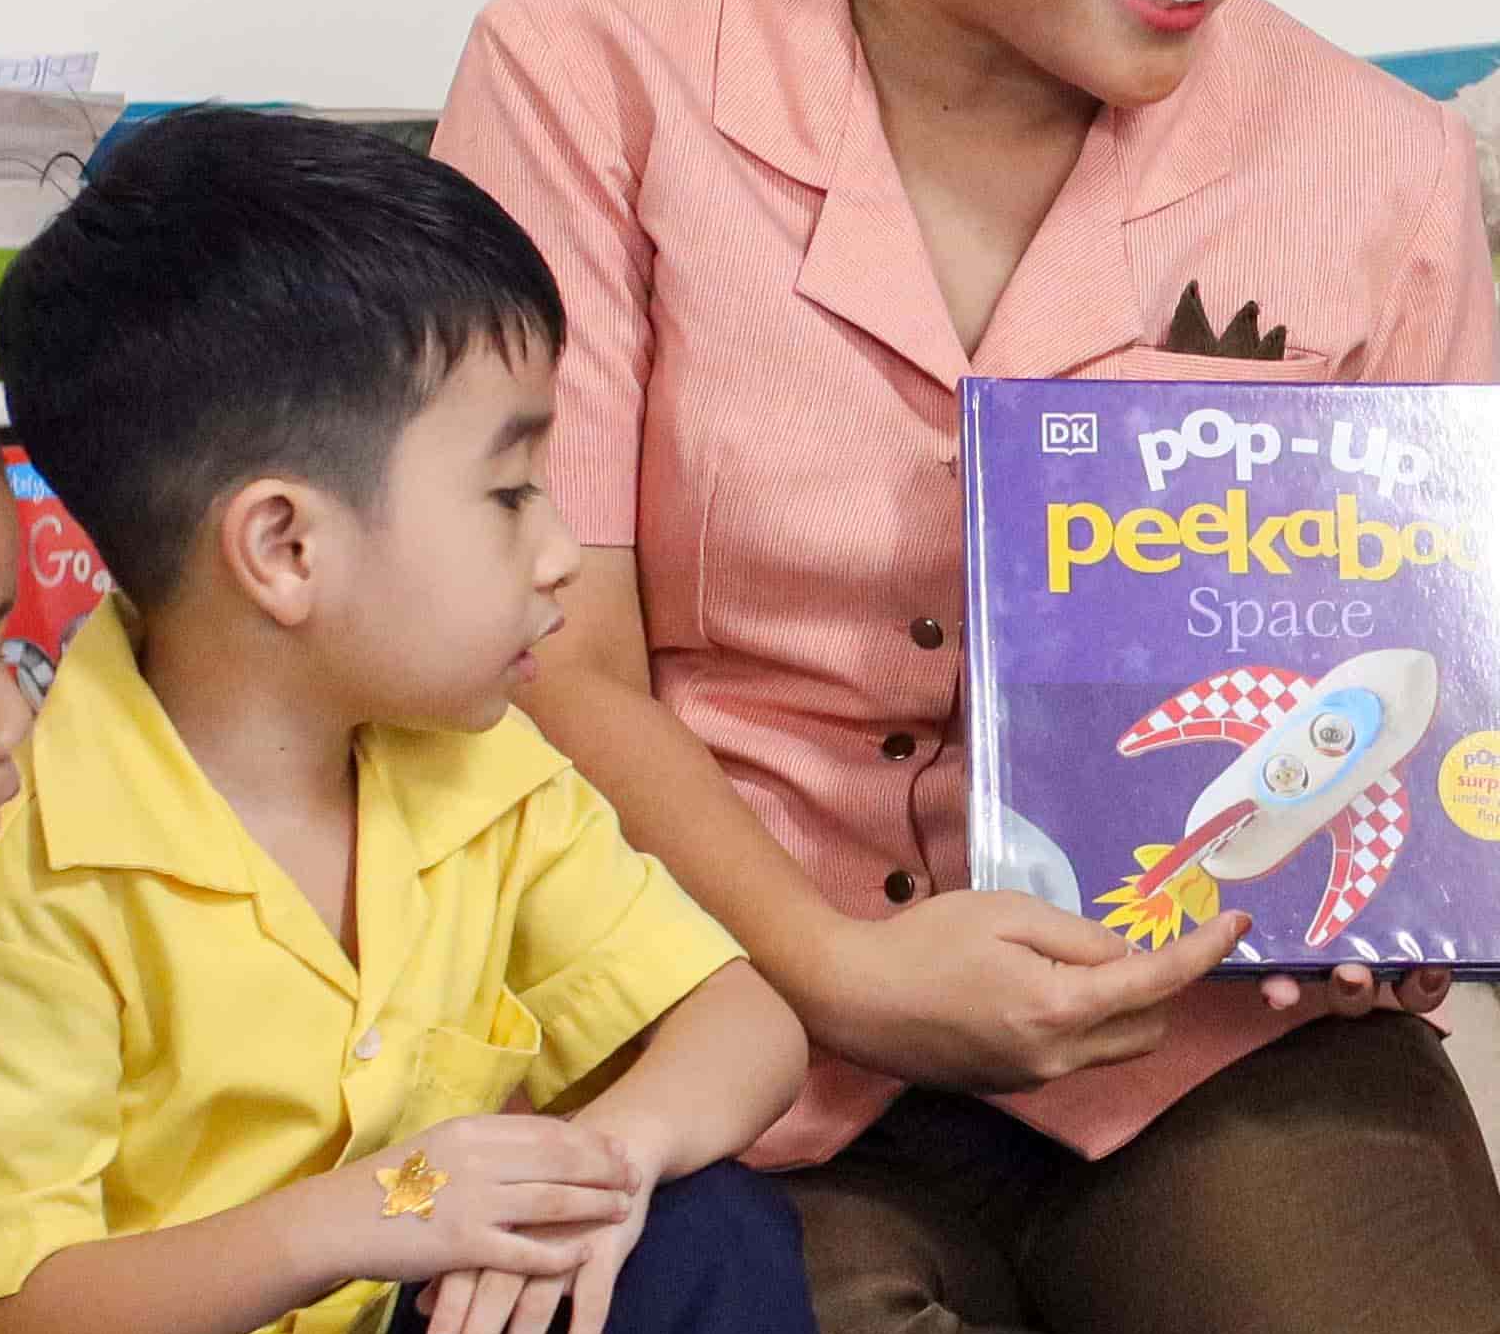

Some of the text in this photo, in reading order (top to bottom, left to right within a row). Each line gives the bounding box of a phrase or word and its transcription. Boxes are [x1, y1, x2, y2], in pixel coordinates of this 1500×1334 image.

[1049, 421, 1094, 447] DK
[1138, 407, 1432, 495] pop-up
[1187, 587, 1374, 653] Space
